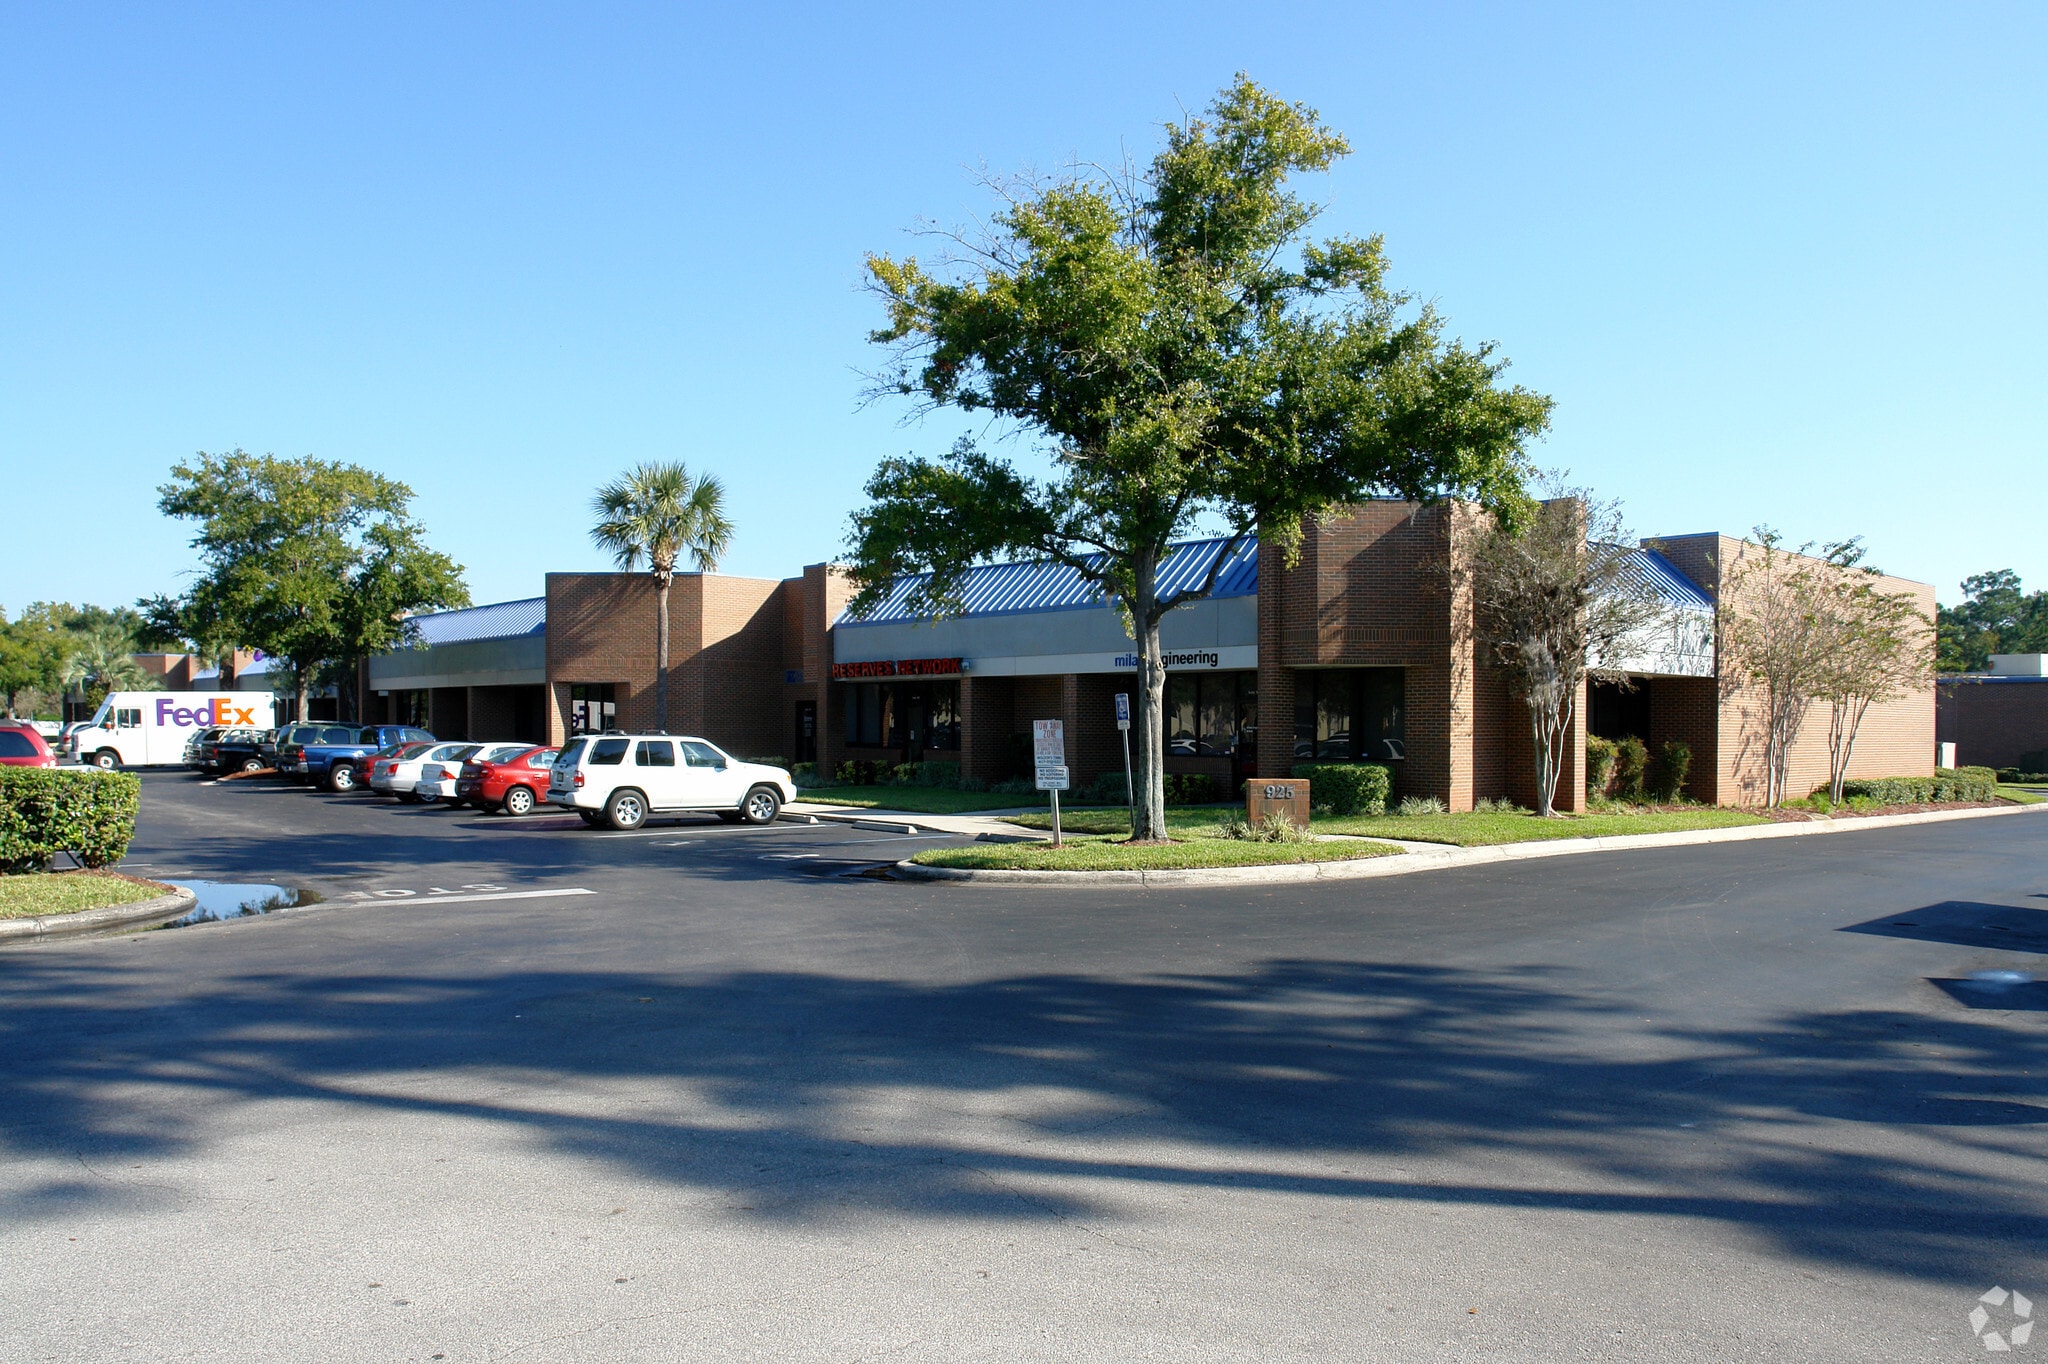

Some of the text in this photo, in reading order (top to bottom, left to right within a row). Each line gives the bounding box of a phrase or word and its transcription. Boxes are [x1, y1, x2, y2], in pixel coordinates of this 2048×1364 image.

[1115, 650, 1218, 668] mila gineering
[832, 658, 962, 678] RESERVES NETWORK
[156, 698, 255, 727] FedEx
[1035, 721, 1048, 731] TOW
[1043, 730, 1057, 739] ZONE
[1265, 785, 1295, 799] 925
